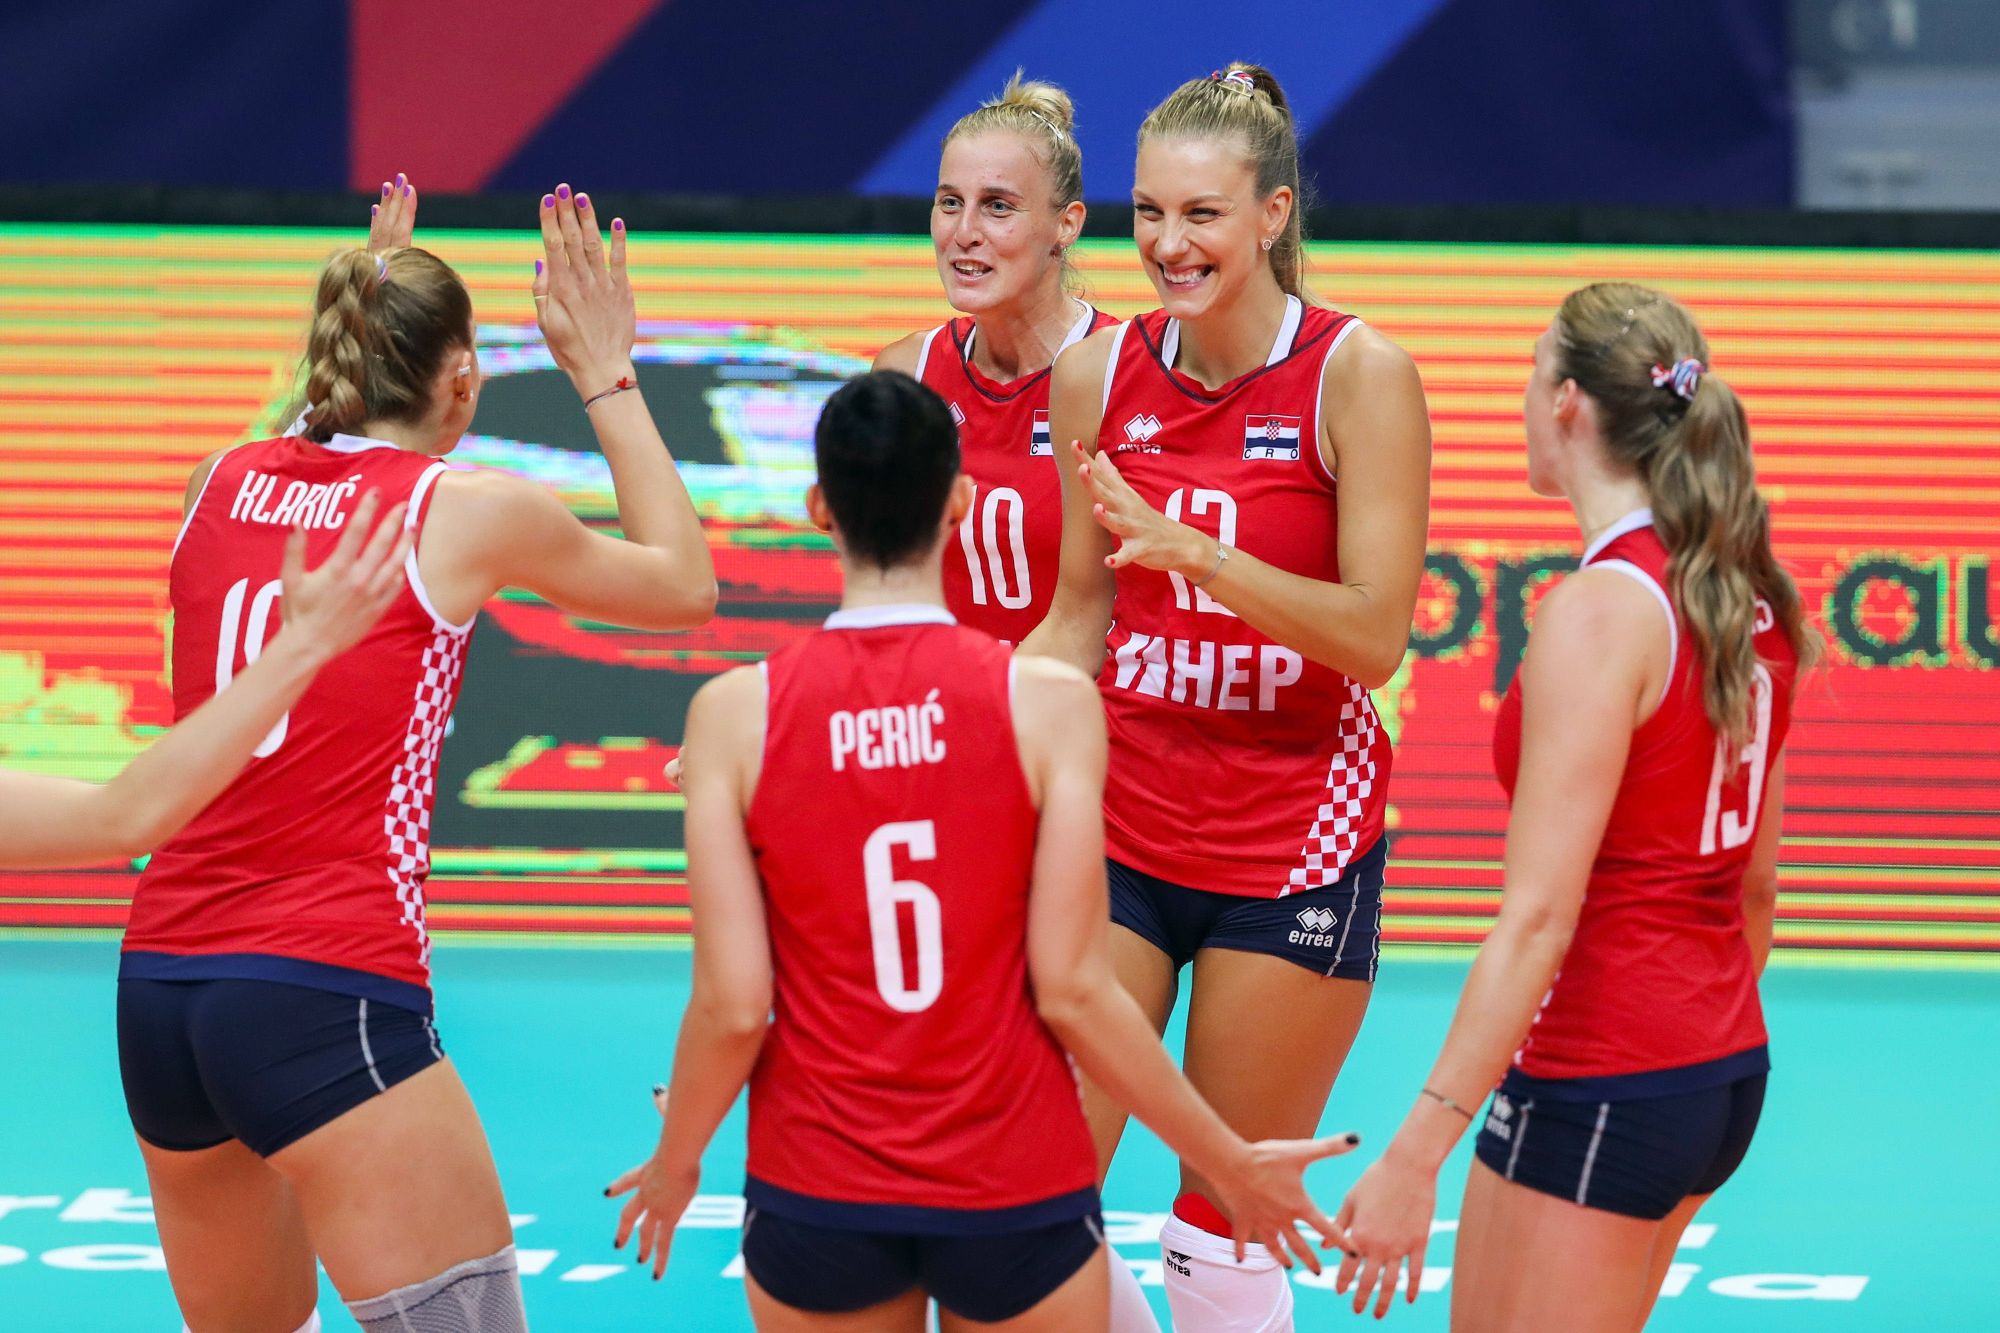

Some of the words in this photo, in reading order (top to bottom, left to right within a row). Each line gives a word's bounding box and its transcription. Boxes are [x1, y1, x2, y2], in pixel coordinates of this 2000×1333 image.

[229, 469, 363, 530] KLARIĆ
[959, 484, 1033, 610] 10
[829, 688, 946, 772] PERIĆ
[863, 819, 944, 1013] 6
[1288, 929, 1334, 948] errea
[1166, 1255, 1191, 1277] errea
